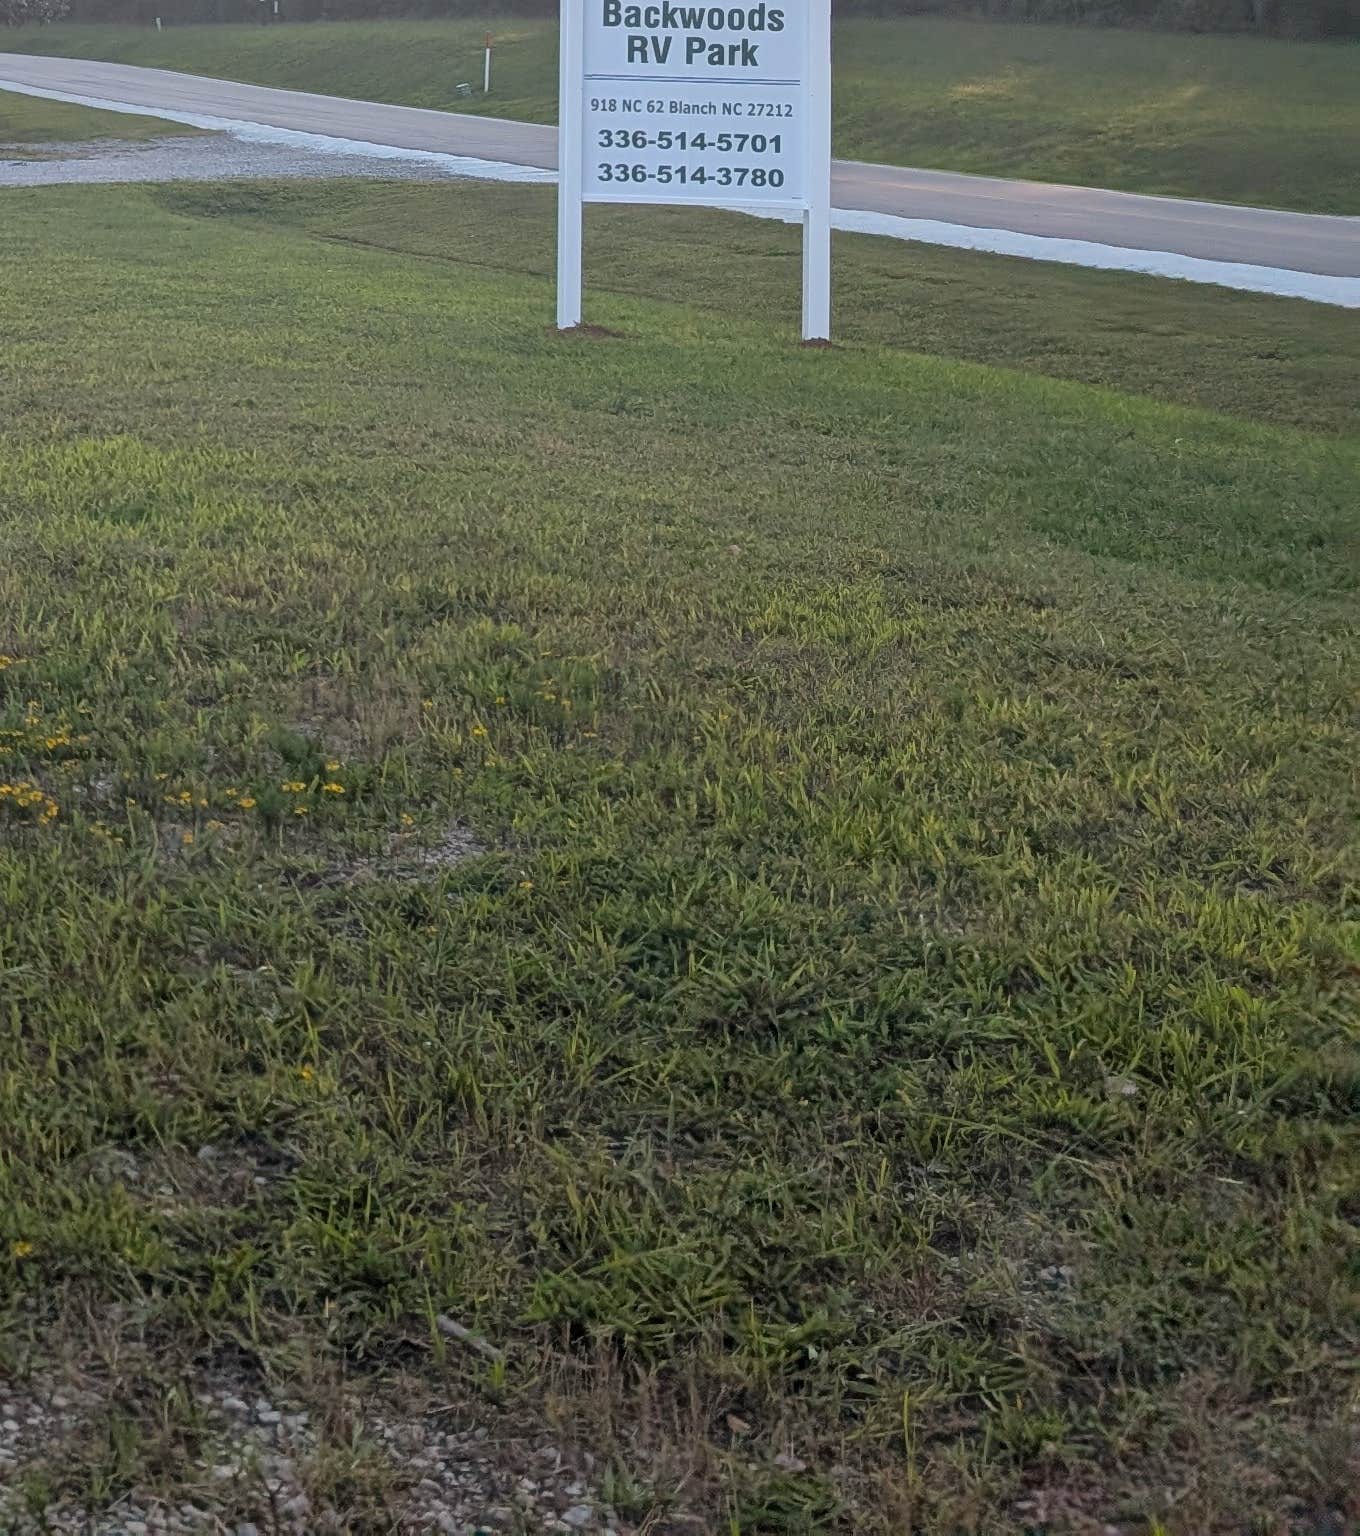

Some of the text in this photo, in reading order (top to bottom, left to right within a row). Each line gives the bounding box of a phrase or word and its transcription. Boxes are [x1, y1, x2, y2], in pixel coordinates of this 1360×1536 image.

[627, 34, 760, 67] RV Park
[590, 98, 793, 118] 918 NC 62 Blanch NC 27212
[598, 129, 781, 154] 336-514-5701
[597, 162, 785, 188] 336-514-3780
